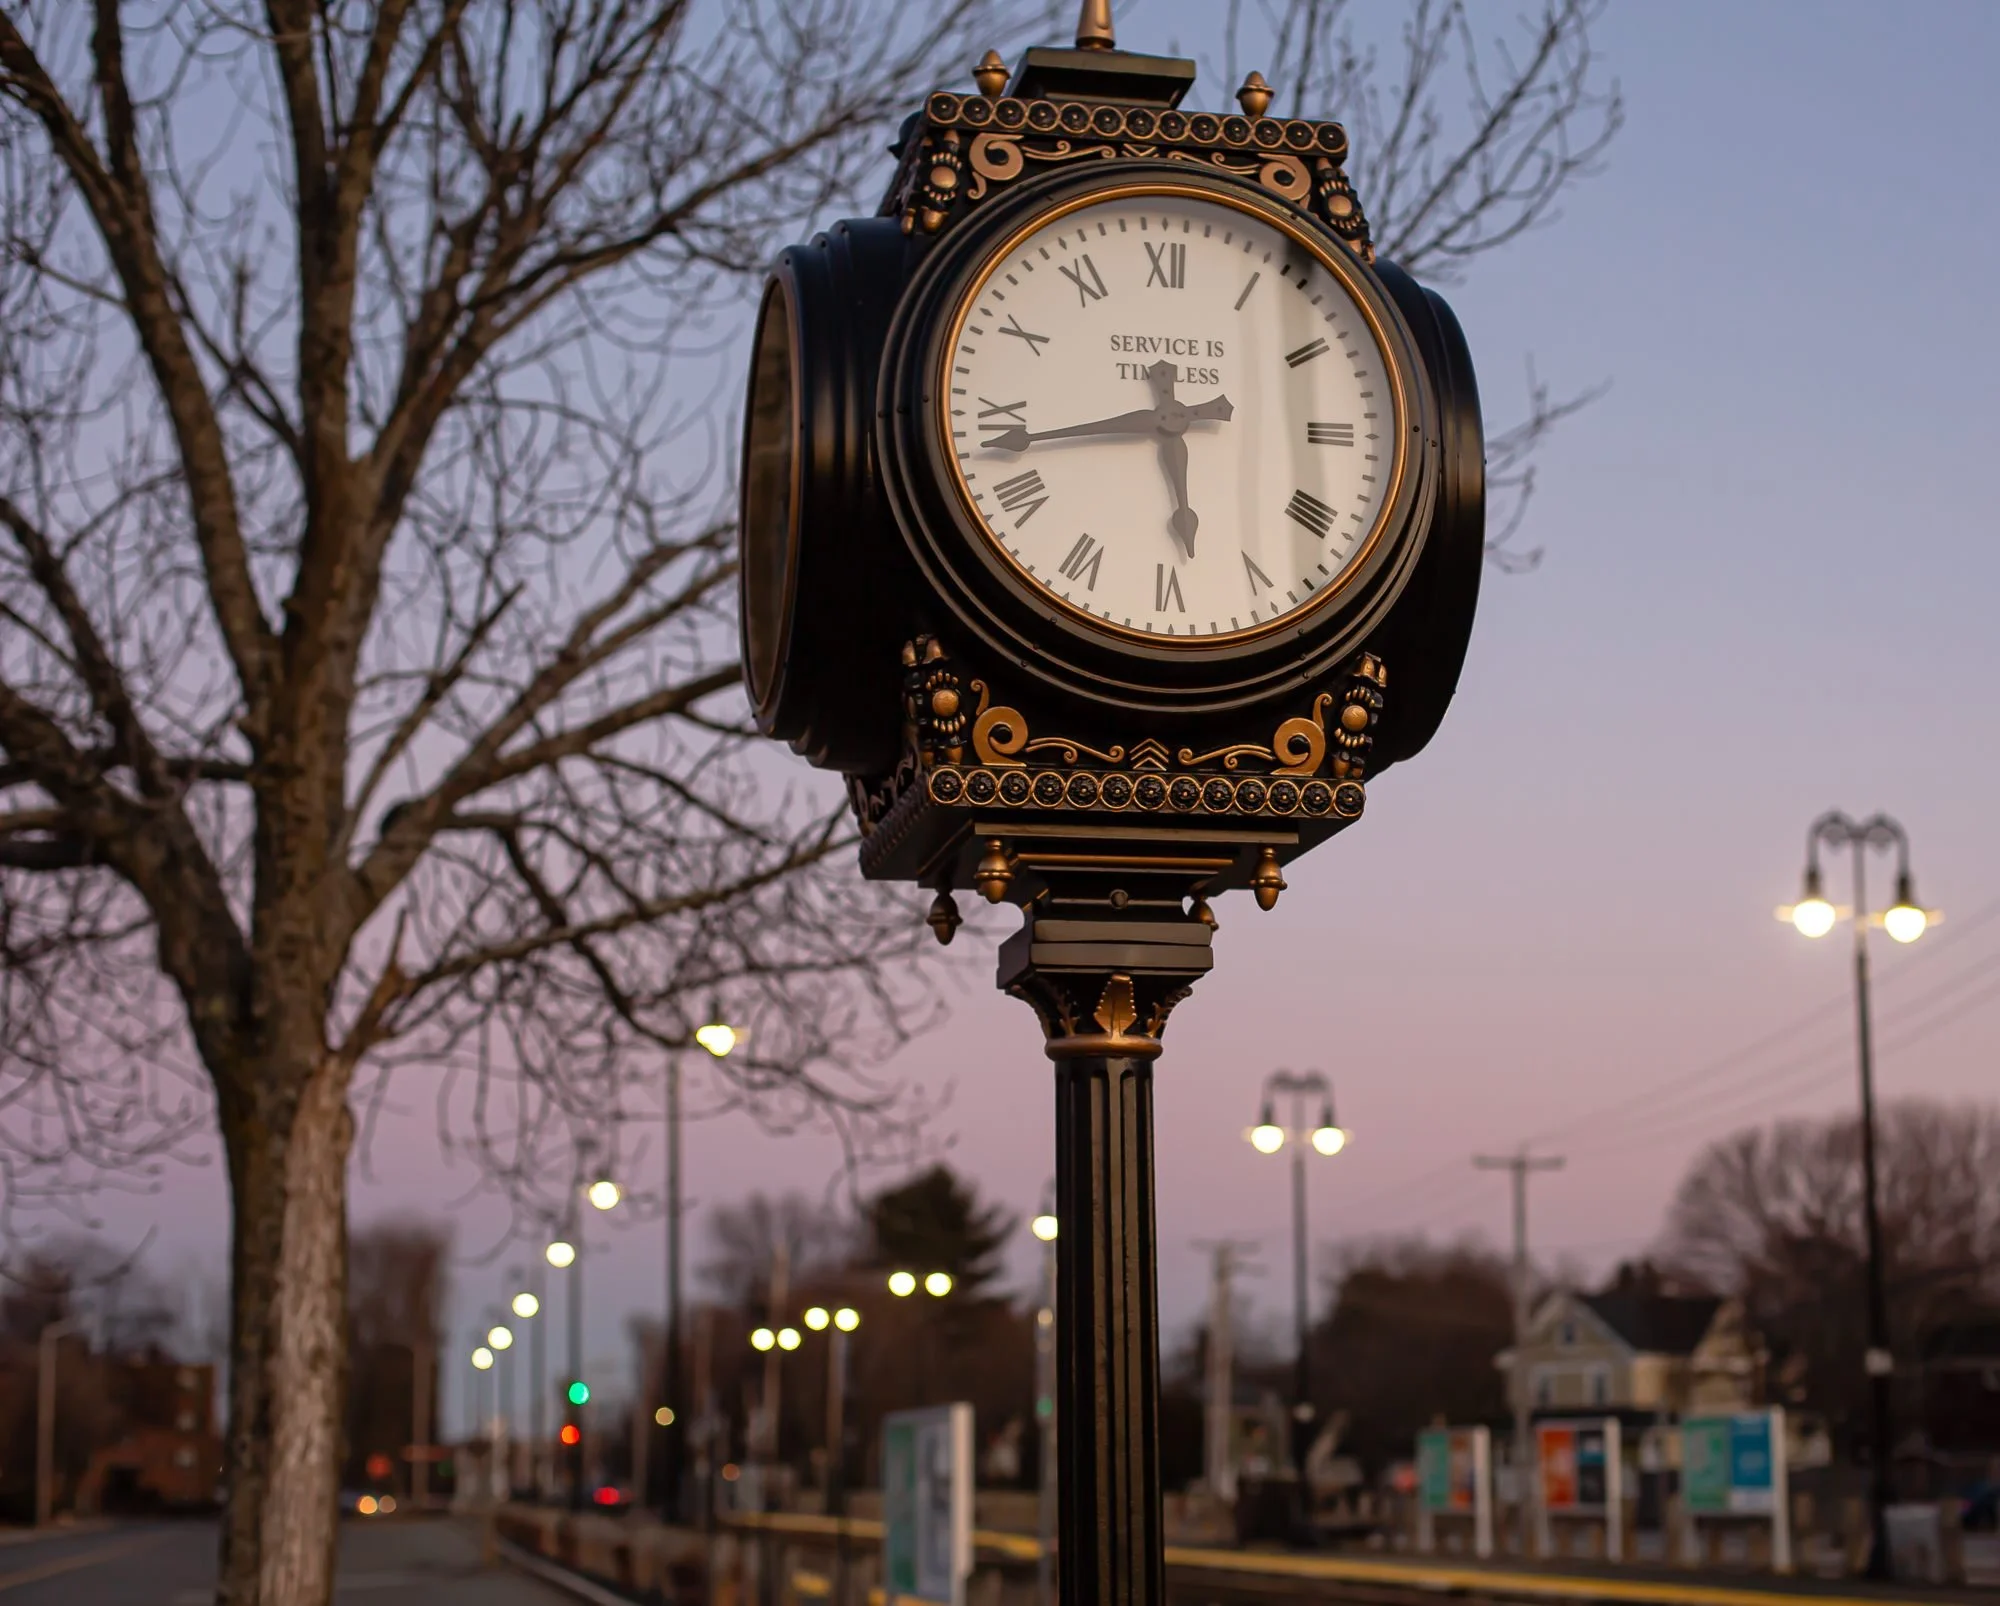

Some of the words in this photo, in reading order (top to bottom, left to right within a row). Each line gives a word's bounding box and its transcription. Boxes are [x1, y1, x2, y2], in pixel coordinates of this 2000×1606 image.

[1058, 253, 1109, 308] XI
[1144, 241, 1186, 289] XII
[1234, 271, 1260, 311] I
[998, 314, 1050, 357] X
[1110, 334, 1200, 356] SERVICE
[1206, 340, 1225, 358] IS
[1285, 337, 1330, 368] II
[1115, 362, 1220, 385] TIMLESS
[1307, 422, 1354, 447] III
[992, 469, 1050, 529] VIII
[1284, 489, 1338, 539] IIII
[1058, 533, 1105, 592] VII
[1241, 550, 1275, 597] V
[1156, 563, 1186, 613] VI
